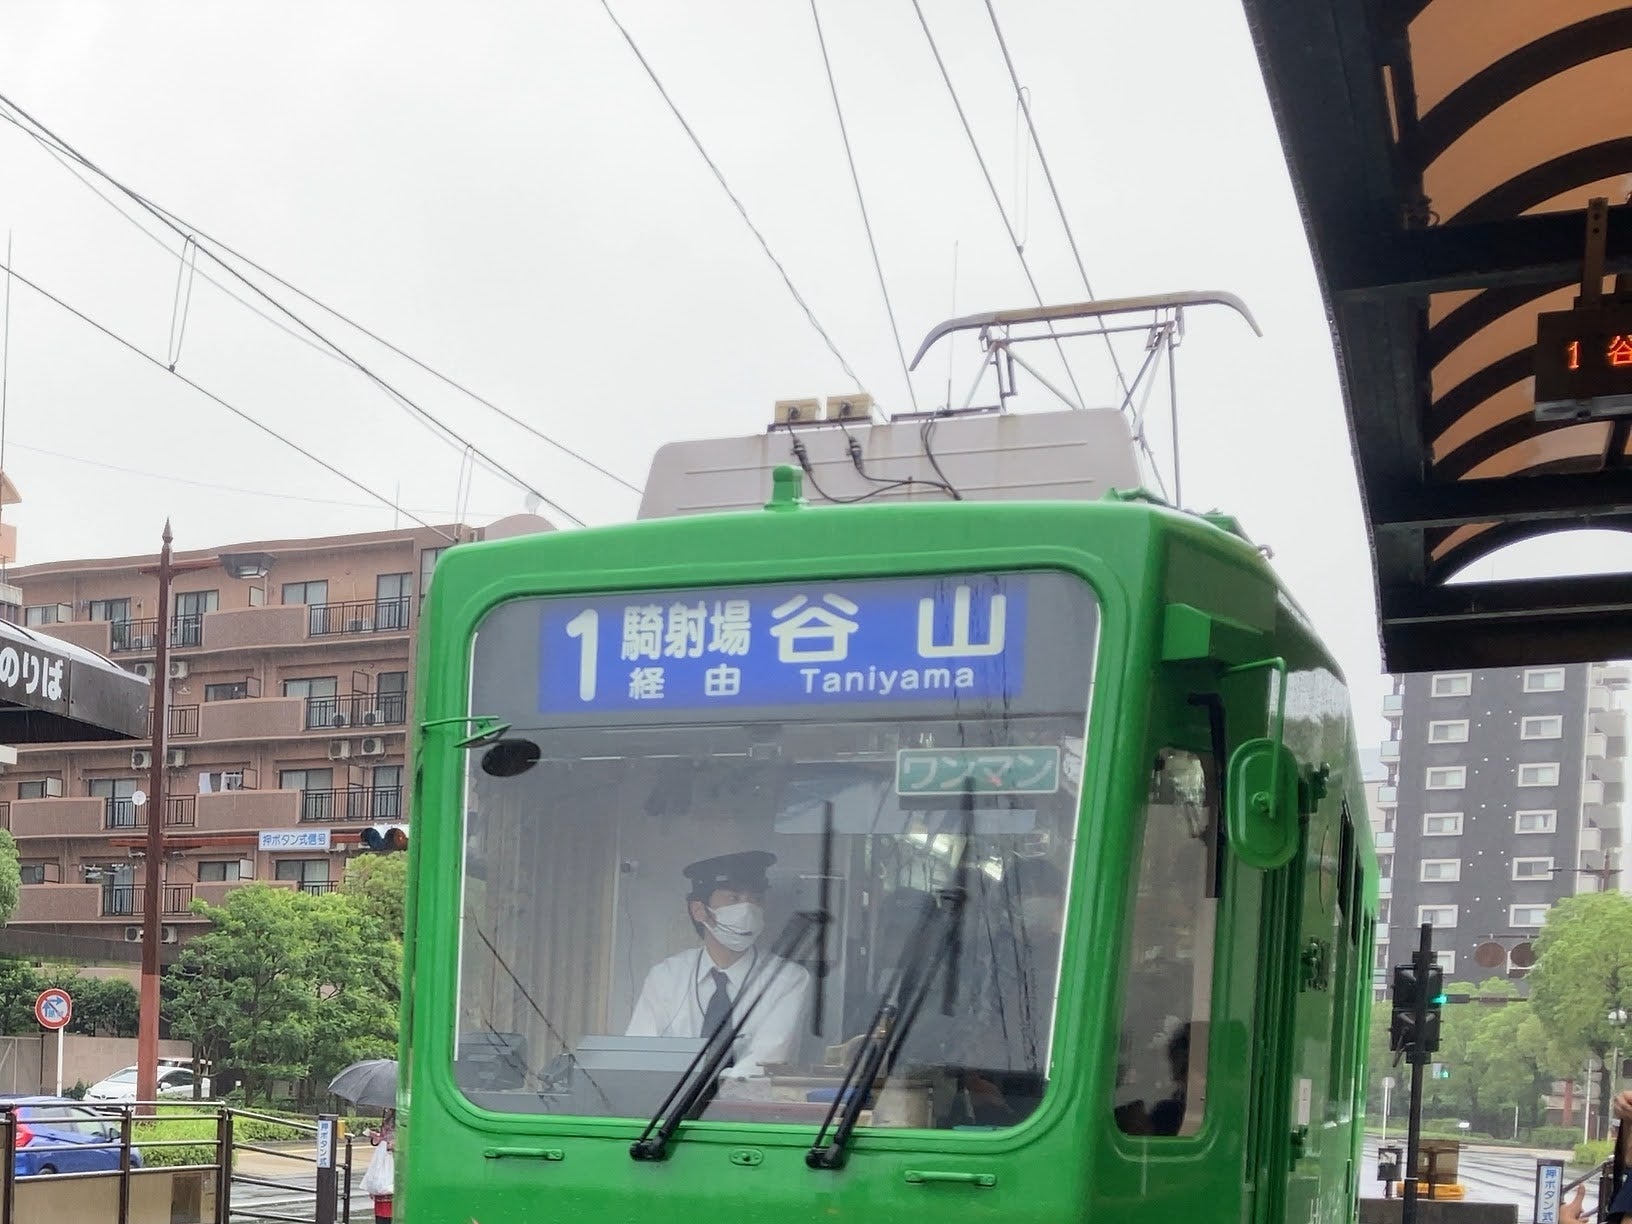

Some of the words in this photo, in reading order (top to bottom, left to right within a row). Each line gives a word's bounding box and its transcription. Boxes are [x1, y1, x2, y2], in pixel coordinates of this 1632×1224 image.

[1567, 341, 1580, 369] 1
[565, 608, 600, 702] 1
[620, 598, 753, 662] 騎射場
[800, 664, 975, 695] Taniyama
[903, 753, 1054, 790] ワンマン
[1541, 1168, 1557, 1222] 押ボタン式
